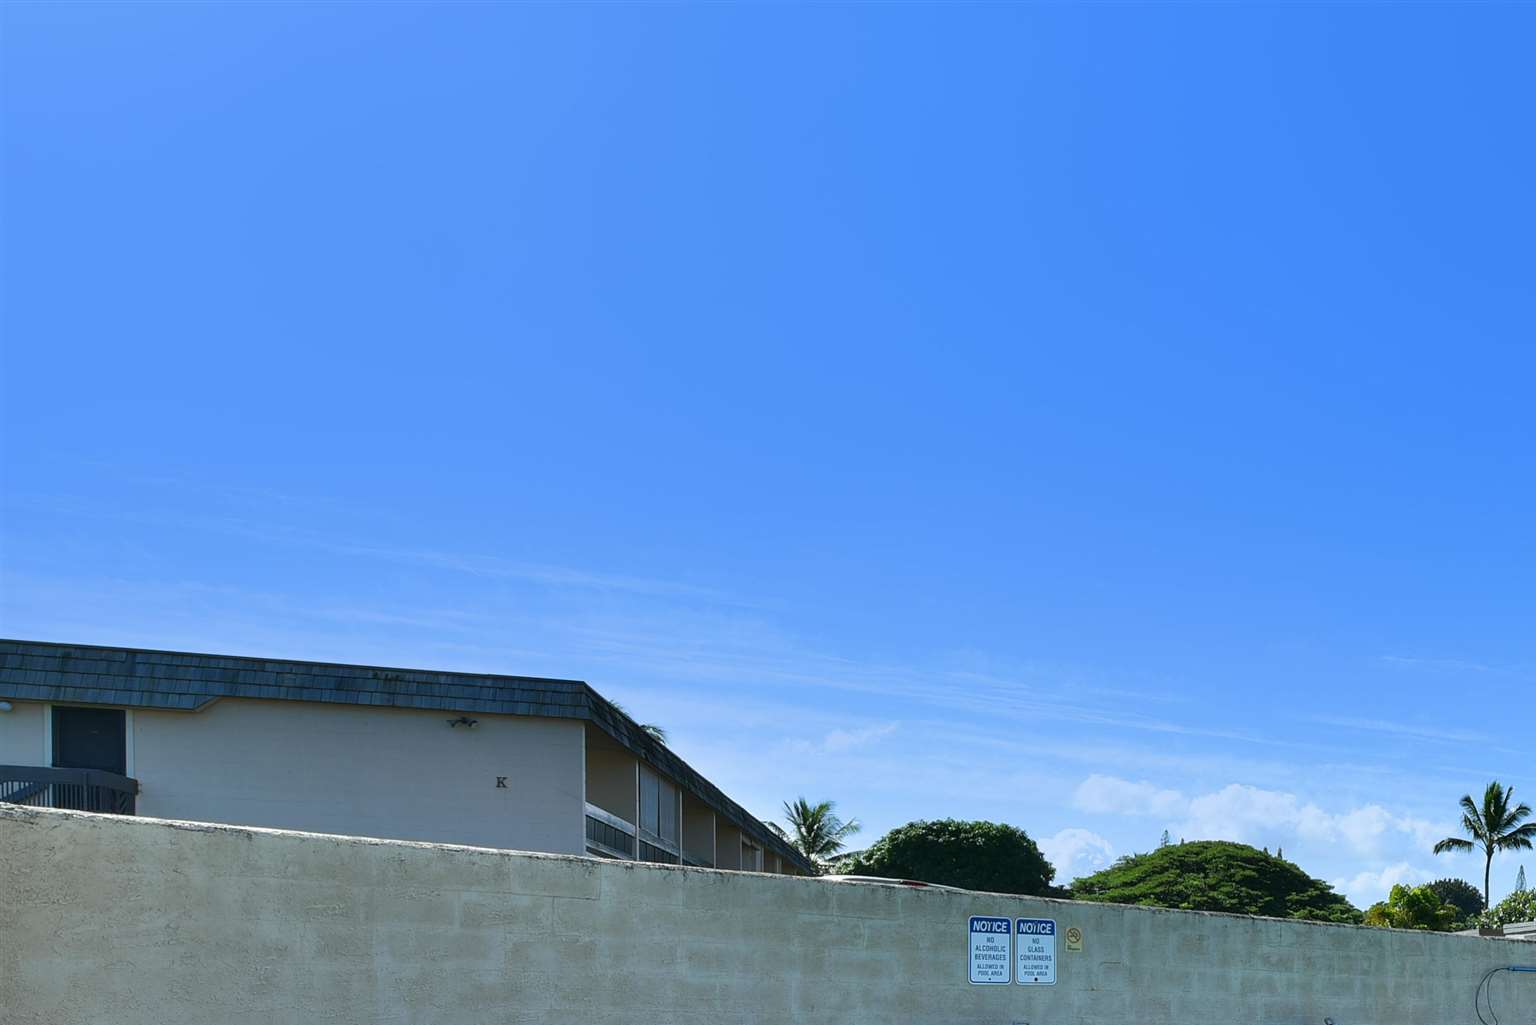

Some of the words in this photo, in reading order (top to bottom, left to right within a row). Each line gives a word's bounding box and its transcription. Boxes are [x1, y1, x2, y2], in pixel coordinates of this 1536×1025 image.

[496, 776, 508, 788] K
[973, 920, 1008, 932] NOTICE
[1020, 922, 1052, 934] NOTICE
[975, 953, 1006, 961] BEVERAGES
[1020, 954, 1052, 962] CONTAINERS
